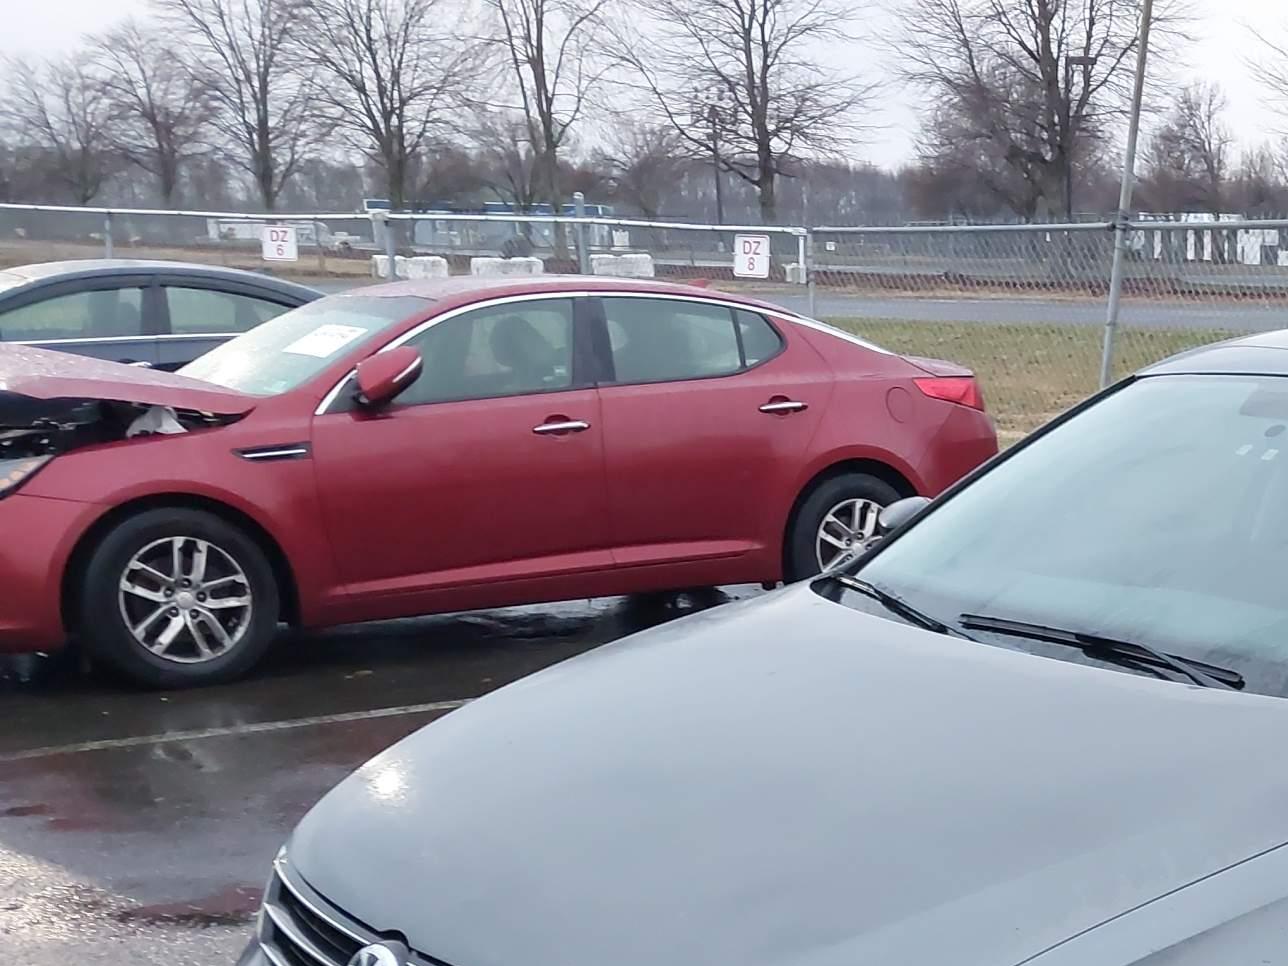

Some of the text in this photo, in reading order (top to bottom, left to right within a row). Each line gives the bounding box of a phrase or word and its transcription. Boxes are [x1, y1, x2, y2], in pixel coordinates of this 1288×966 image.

[270, 230, 289, 242] DZ
[276, 244, 285, 256] 6
[743, 240, 761, 255] DZ
[747, 256, 756, 271] 8
